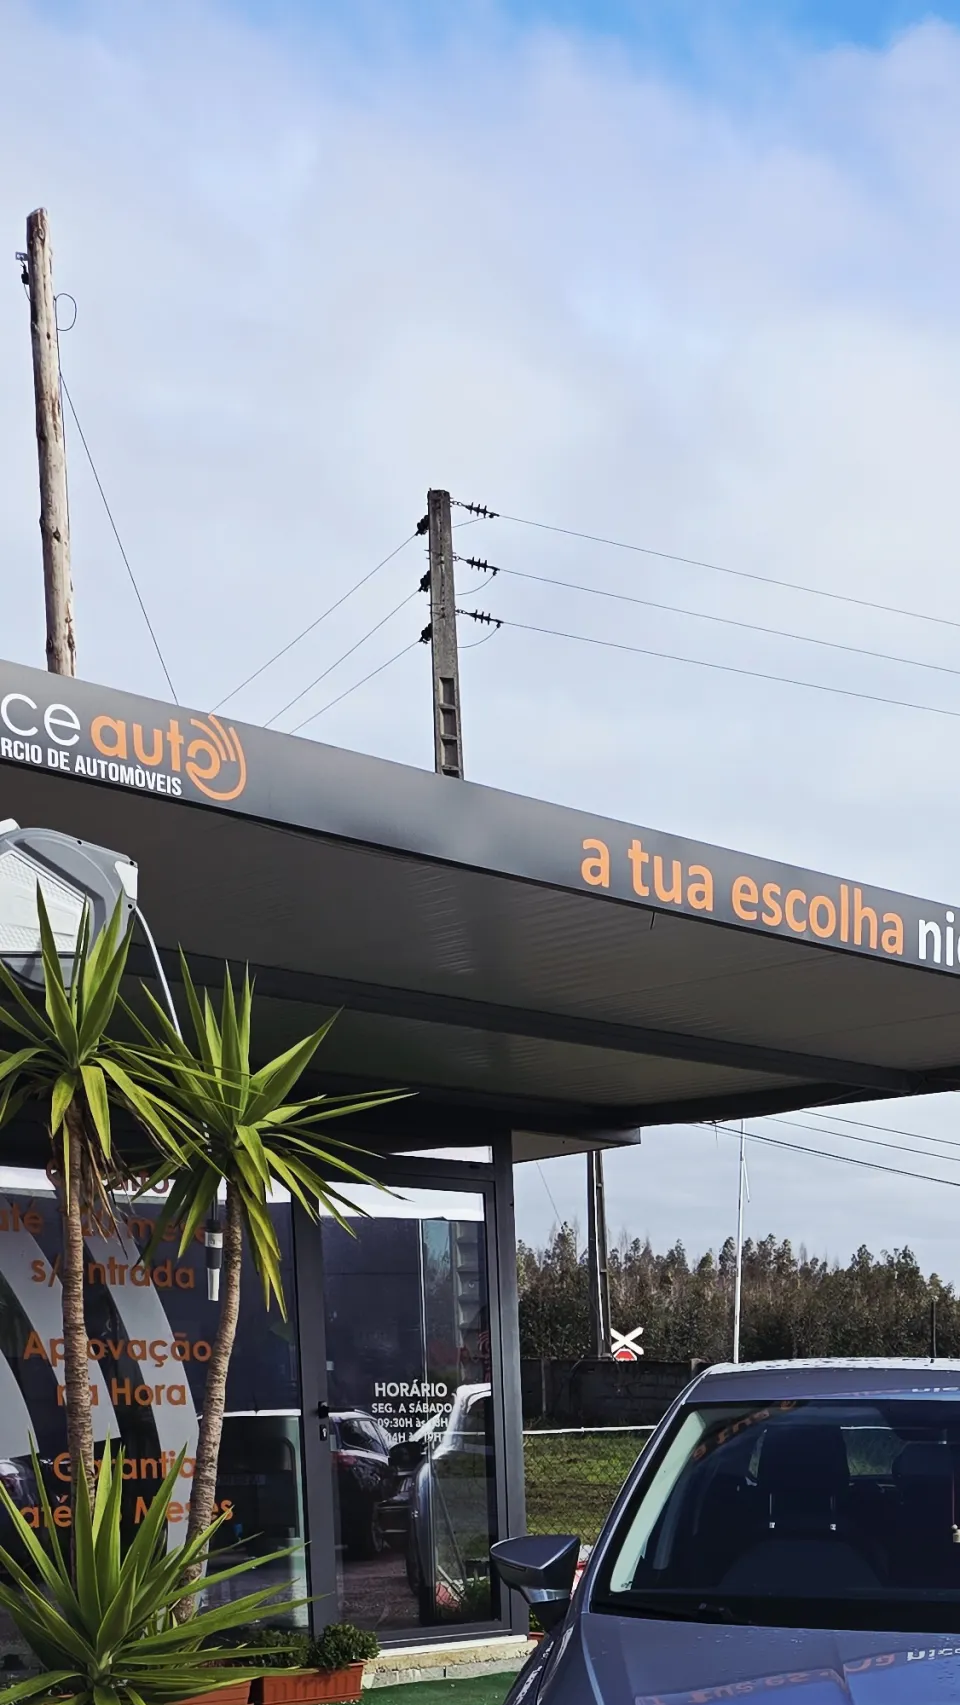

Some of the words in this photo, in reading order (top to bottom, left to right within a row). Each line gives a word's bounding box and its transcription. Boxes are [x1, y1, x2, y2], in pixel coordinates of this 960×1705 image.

[47, 747, 71, 771] DE
[581, 838, 610, 888] a
[627, 839, 714, 912] tua
[731, 883, 904, 956] escolha
[31, 1256, 196, 1289] s/ntrada
[23, 1330, 213, 1368] Apovação
[111, 1377, 187, 1406] Hora
[374, 1379, 448, 1397] HORÁRIO
[371, 1403, 396, 1413] SEG.
[398, 1403, 406, 1413] A
[408, 1401, 453, 1413] SÁBADO
[377, 1418, 413, 1428] 09:30H
